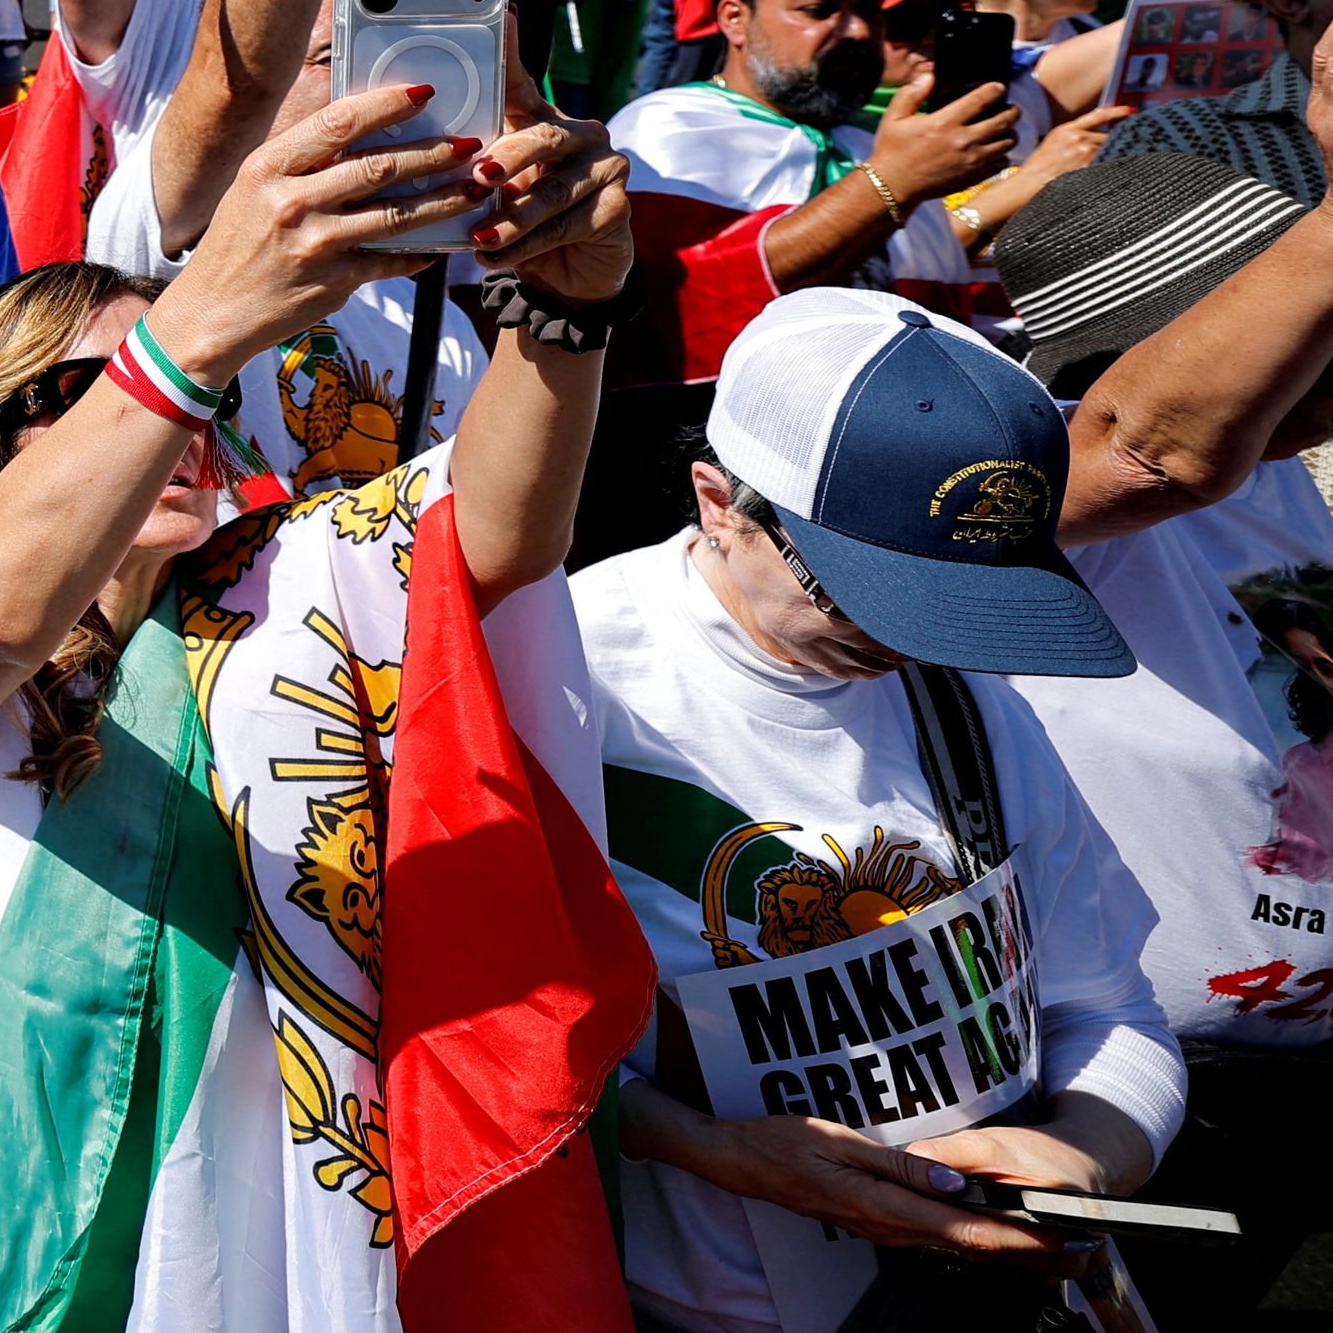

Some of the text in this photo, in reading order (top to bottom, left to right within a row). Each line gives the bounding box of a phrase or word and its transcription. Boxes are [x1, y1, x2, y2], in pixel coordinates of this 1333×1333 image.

[935, 459, 1026, 499] CONSTITUTIONALIST
[929, 499, 942, 518] THE
[1250, 893, 1326, 935] Asra
[728, 937, 945, 1066] MAKE
[759, 1030, 960, 1131] GREAT
